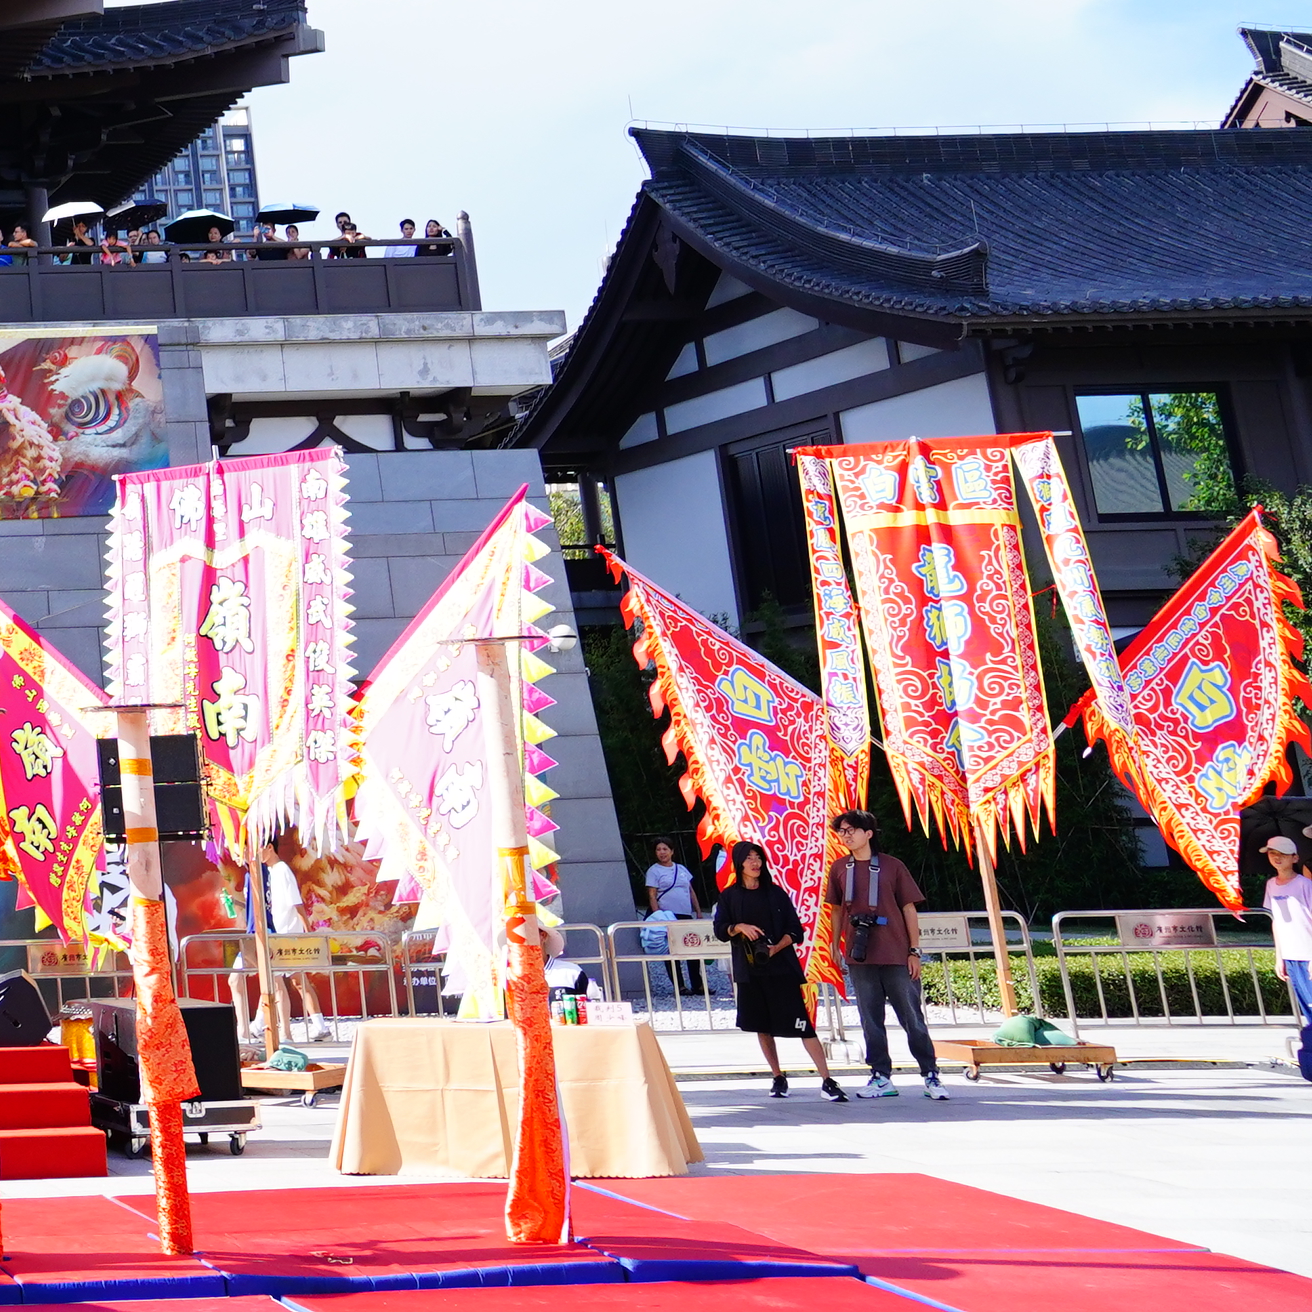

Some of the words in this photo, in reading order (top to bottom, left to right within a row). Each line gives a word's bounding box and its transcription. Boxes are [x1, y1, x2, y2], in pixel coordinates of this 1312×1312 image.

[860, 457, 993, 505] 白雲區
[198, 575, 261, 750] 嶺南
